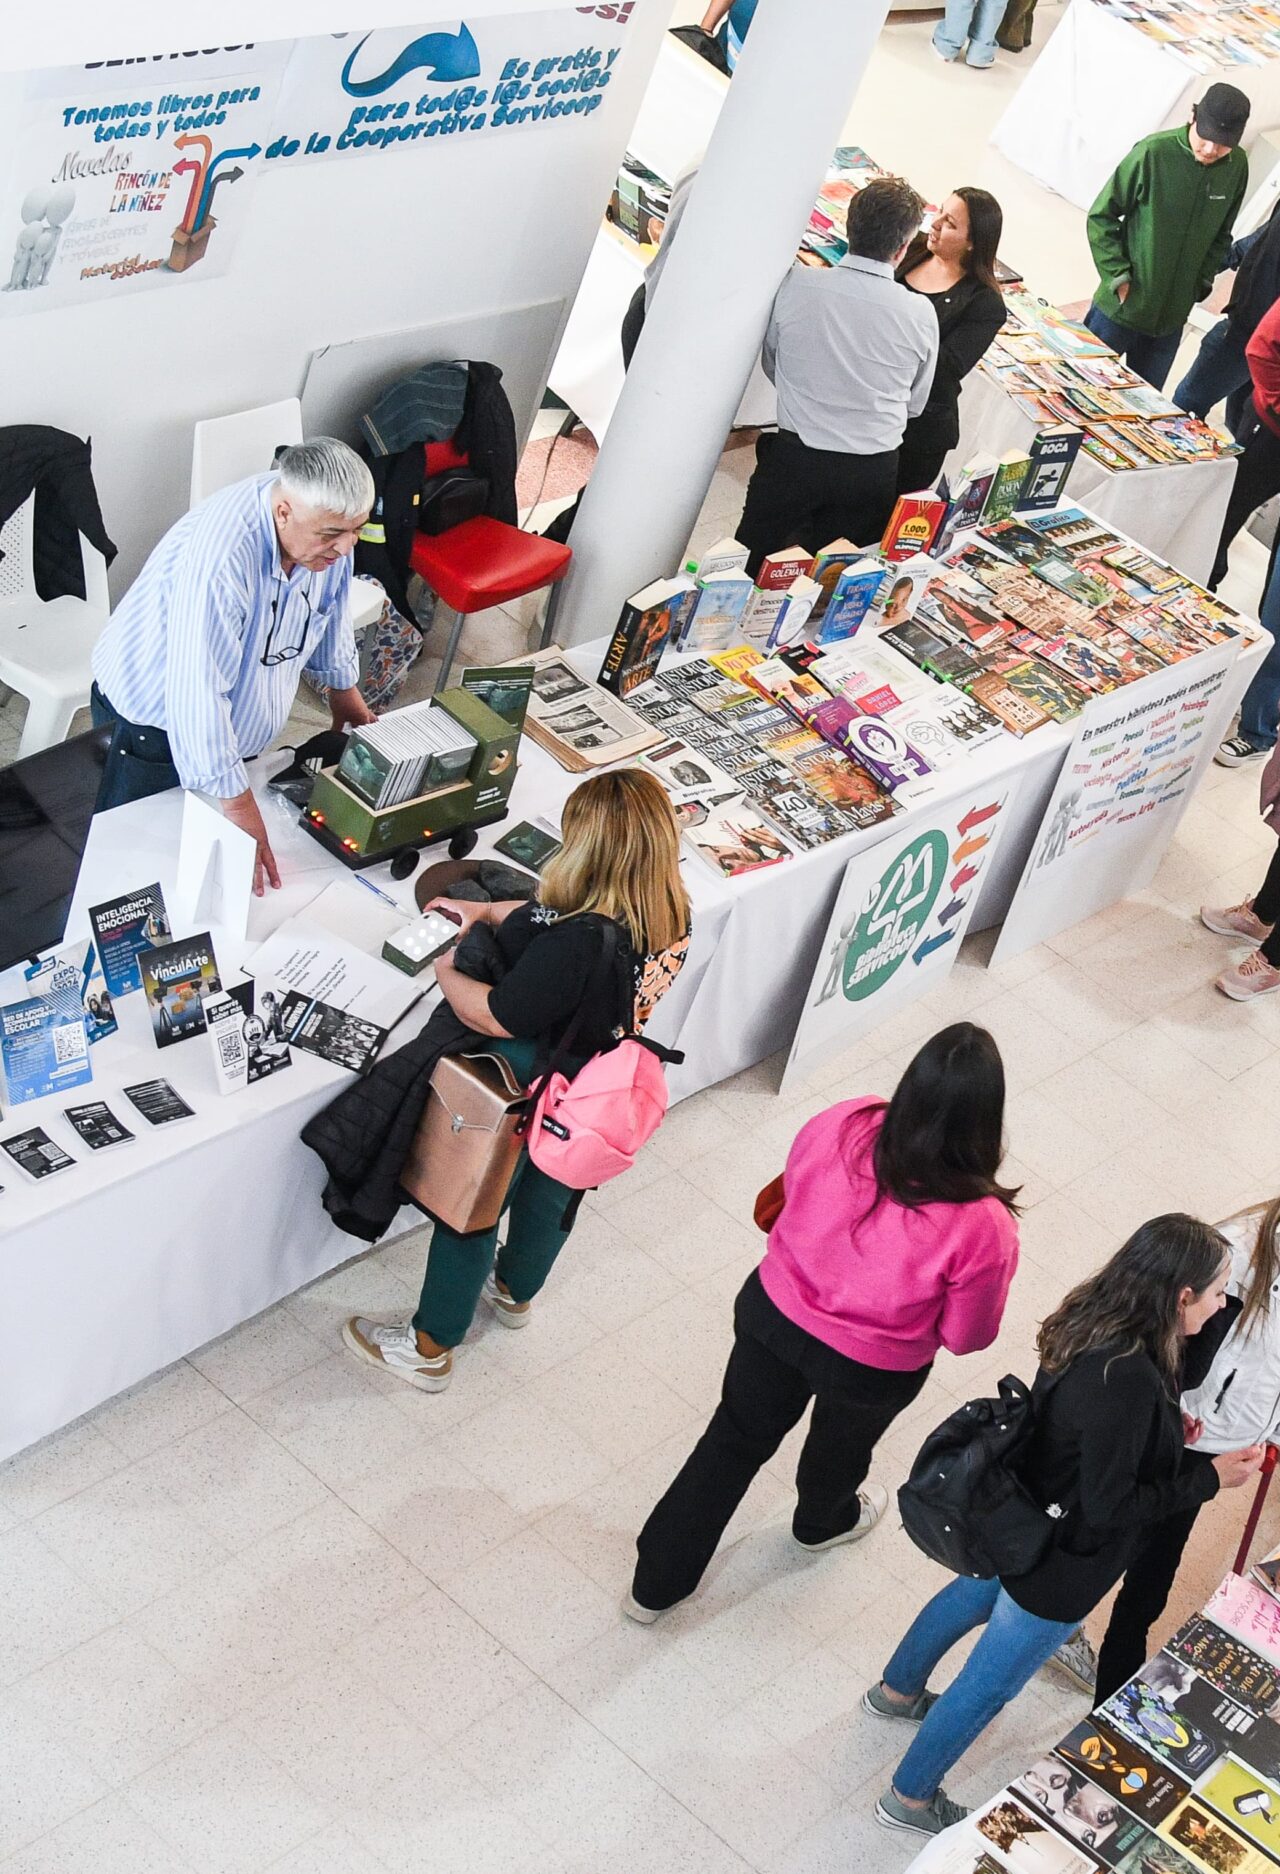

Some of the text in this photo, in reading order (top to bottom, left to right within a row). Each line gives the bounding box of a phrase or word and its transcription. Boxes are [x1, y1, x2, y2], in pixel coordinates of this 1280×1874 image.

[500, 46, 622, 82] Es gratis y
[62, 86, 261, 127] Tenemos libros para
[348, 103, 408, 129] para
[93, 109, 227, 143] todas y todos
[265, 93, 603, 160] de la Cooperativa Servicoop
[158, 171, 173, 189] DE
[109, 193, 128, 213] LA
[1039, 443, 1069, 455] BOCA
[770, 568, 807, 579] GOLEMAN
[607, 630, 628, 673] ARTE
[656, 658, 711, 687] HISTORIA
[670, 670, 726, 698] HISTORIA
[750, 719, 801, 744] HISTORIA
[1081, 730, 1093, 742] En
[1093, 715, 1126, 735] nuestra
[1126, 697, 1164, 723] biblioteca
[782, 795, 808, 813] 40
[843, 800, 886, 824] Mayas
[95, 895, 155, 924] INTELIGENCIA
[97, 907, 149, 933] EMOCIONAL
[52, 965, 77, 985] EXPO
[149, 954, 210, 982] VinculArte
[3, 1018, 41, 1035] ESCOLAR
[1193, 1635, 1210, 1656] AÑO
[1213, 1648, 1237, 1676] LARGO
[1143, 1779, 1174, 1810] Dolores Reyes
